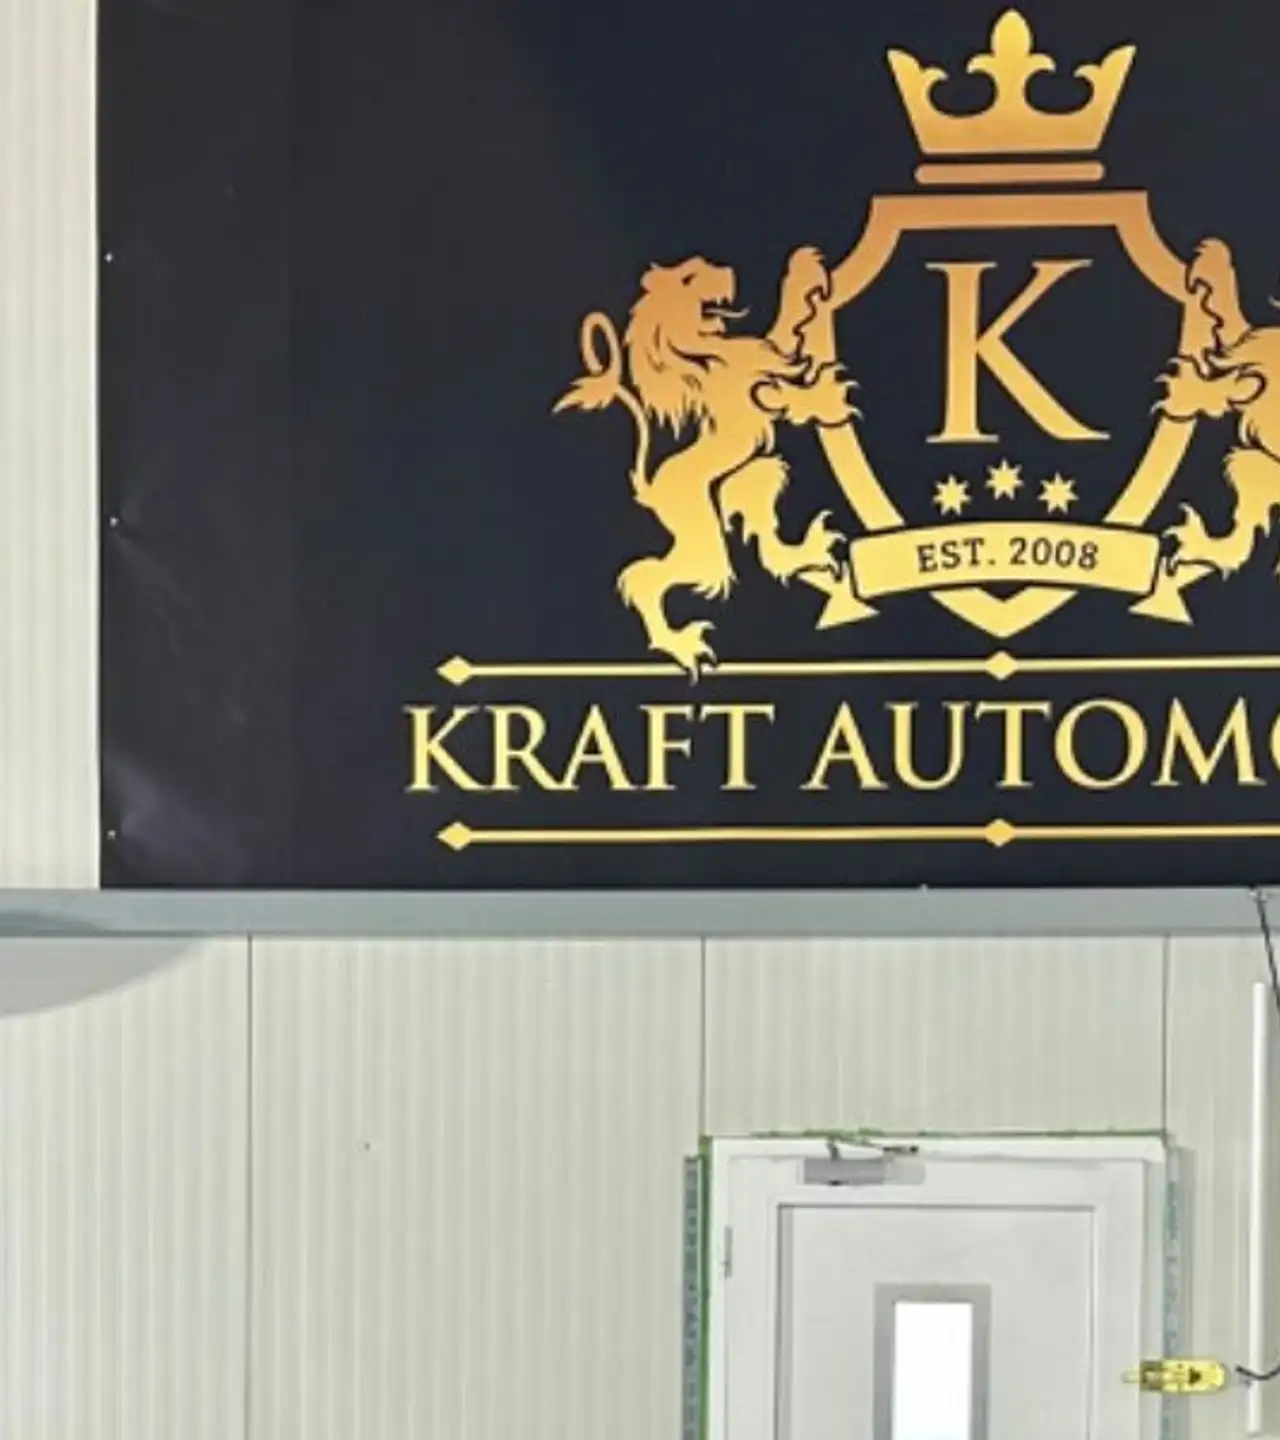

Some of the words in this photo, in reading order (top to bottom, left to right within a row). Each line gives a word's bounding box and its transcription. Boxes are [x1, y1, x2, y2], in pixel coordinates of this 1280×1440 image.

[925, 258, 1110, 443] K
[916, 537, 996, 574] EST.
[1009, 537, 1099, 571] 2008
[404, 701, 774, 792] KRAFT
